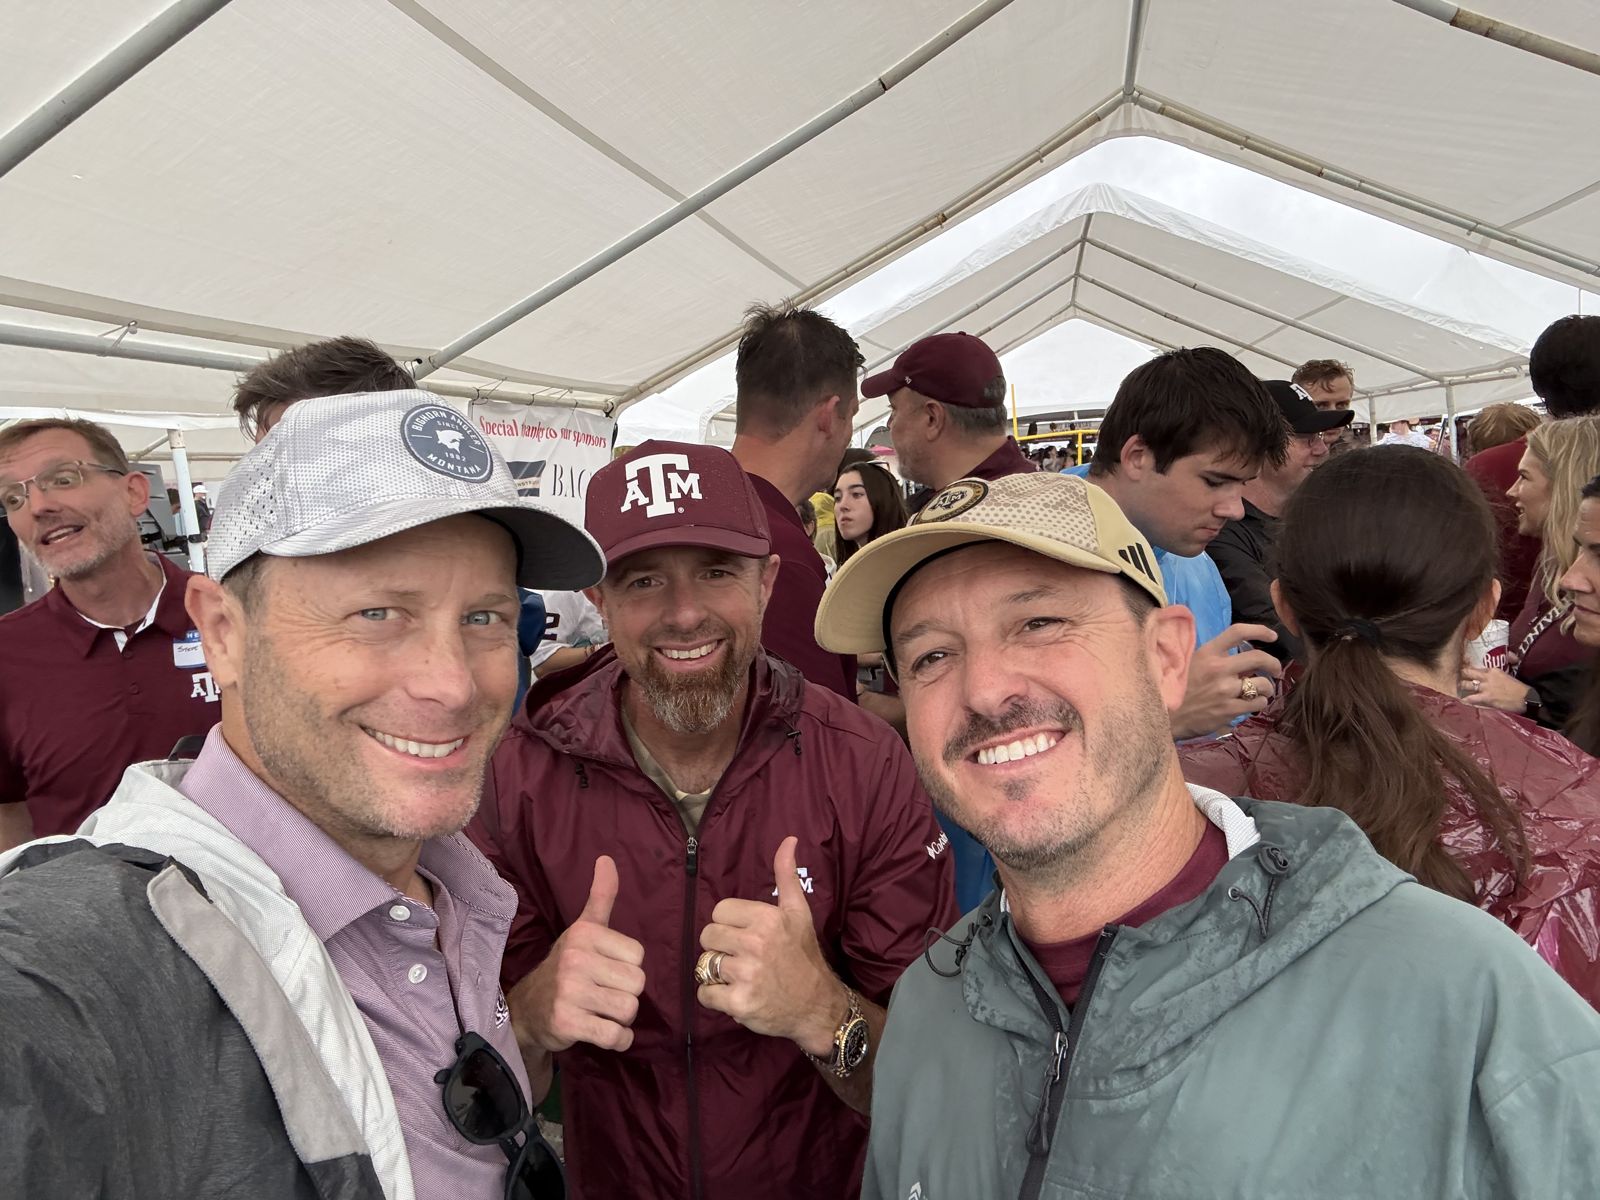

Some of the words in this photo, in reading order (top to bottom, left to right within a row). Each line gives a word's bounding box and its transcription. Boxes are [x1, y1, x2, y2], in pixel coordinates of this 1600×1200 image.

[411, 410, 447, 431] BIGHORN
[450, 414, 481, 445] ANGLER
[436, 420, 459, 430] SINCE
[480, 415, 518, 436] Special
[573, 430, 606, 448] sponsors
[427, 453, 482, 474] MONTANA
